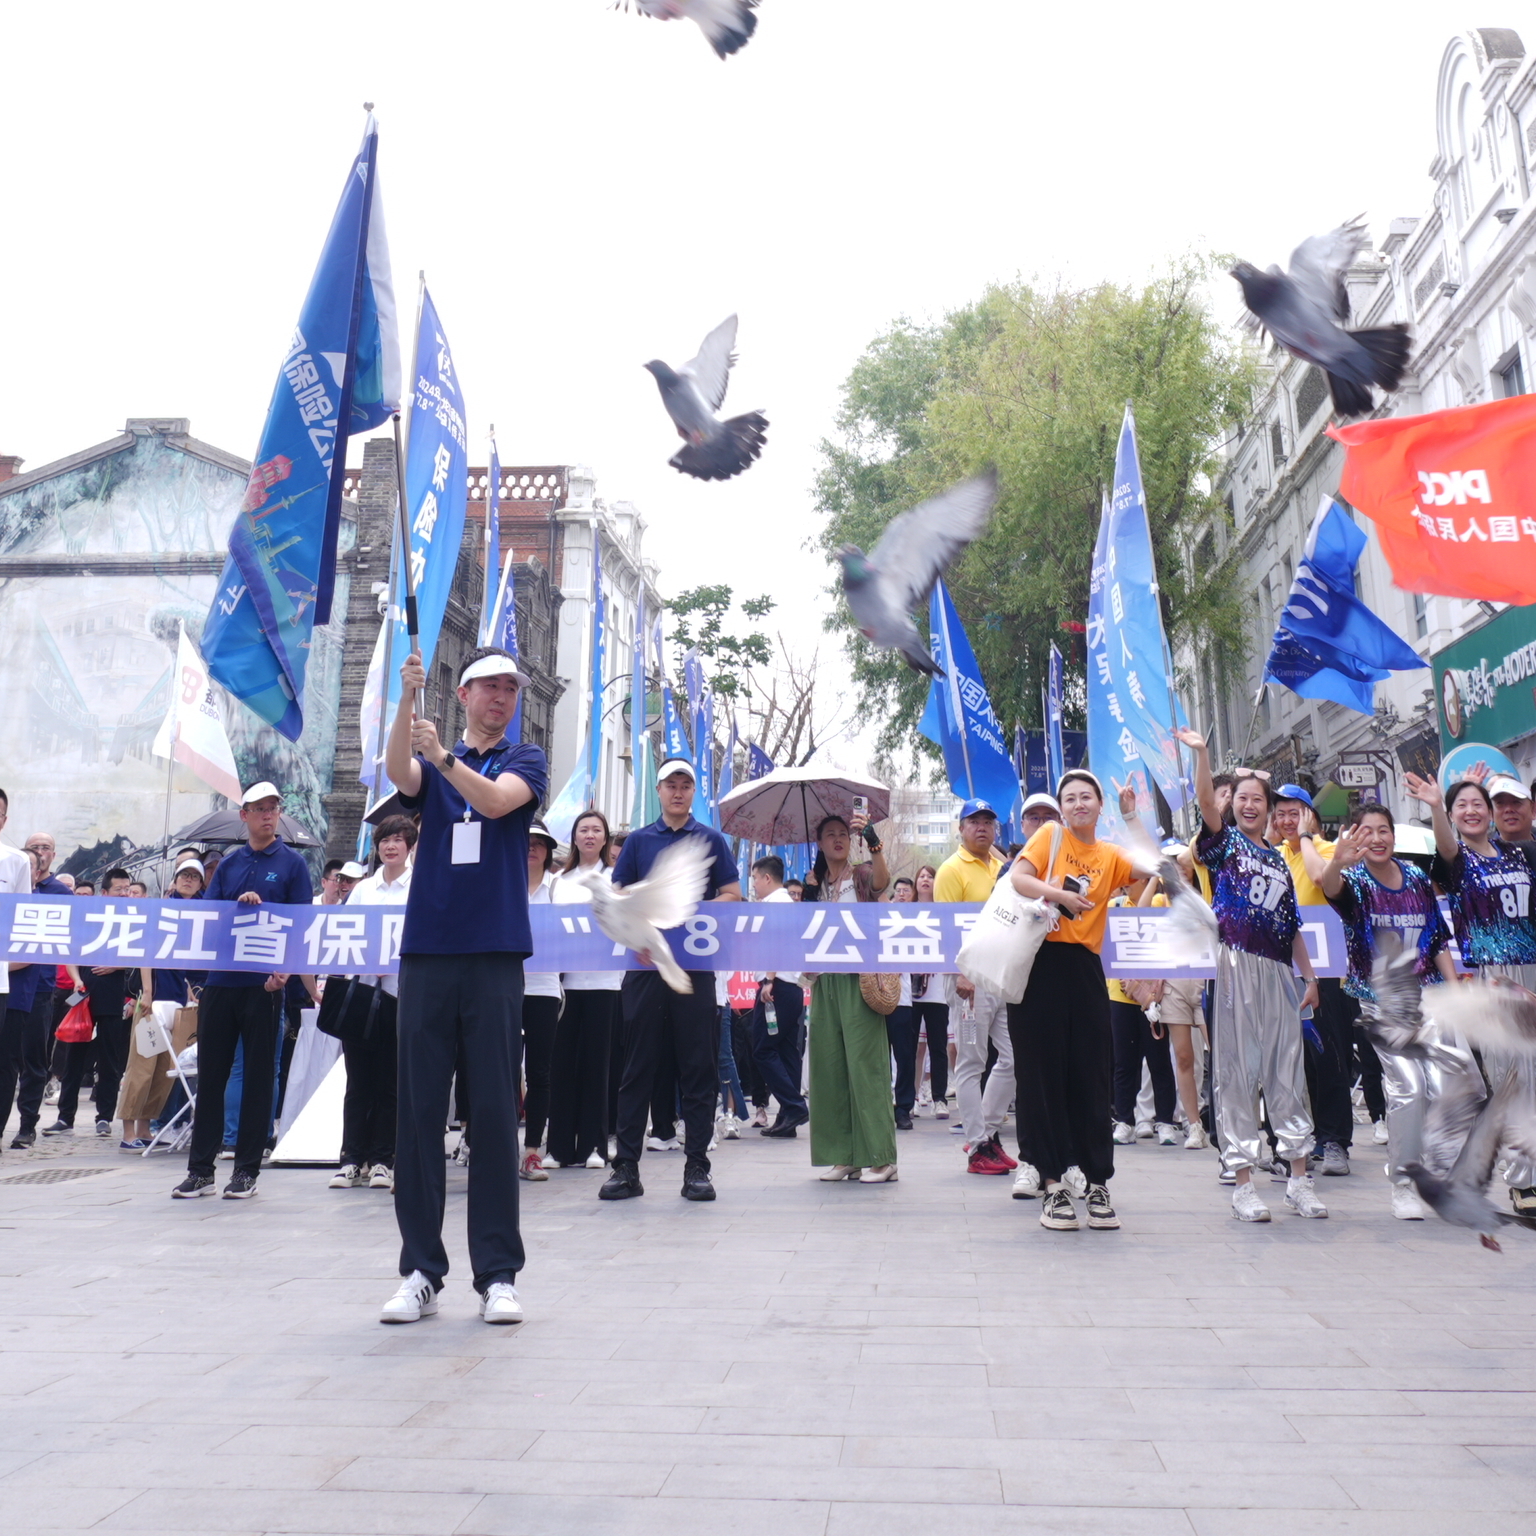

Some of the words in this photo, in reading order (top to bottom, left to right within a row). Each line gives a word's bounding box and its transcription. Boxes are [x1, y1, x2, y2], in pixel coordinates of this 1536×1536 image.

[968, 716, 1005, 755] TAIPING
[994, 905, 1019, 926] AIGLE
[1370, 913, 1392, 927] THE
